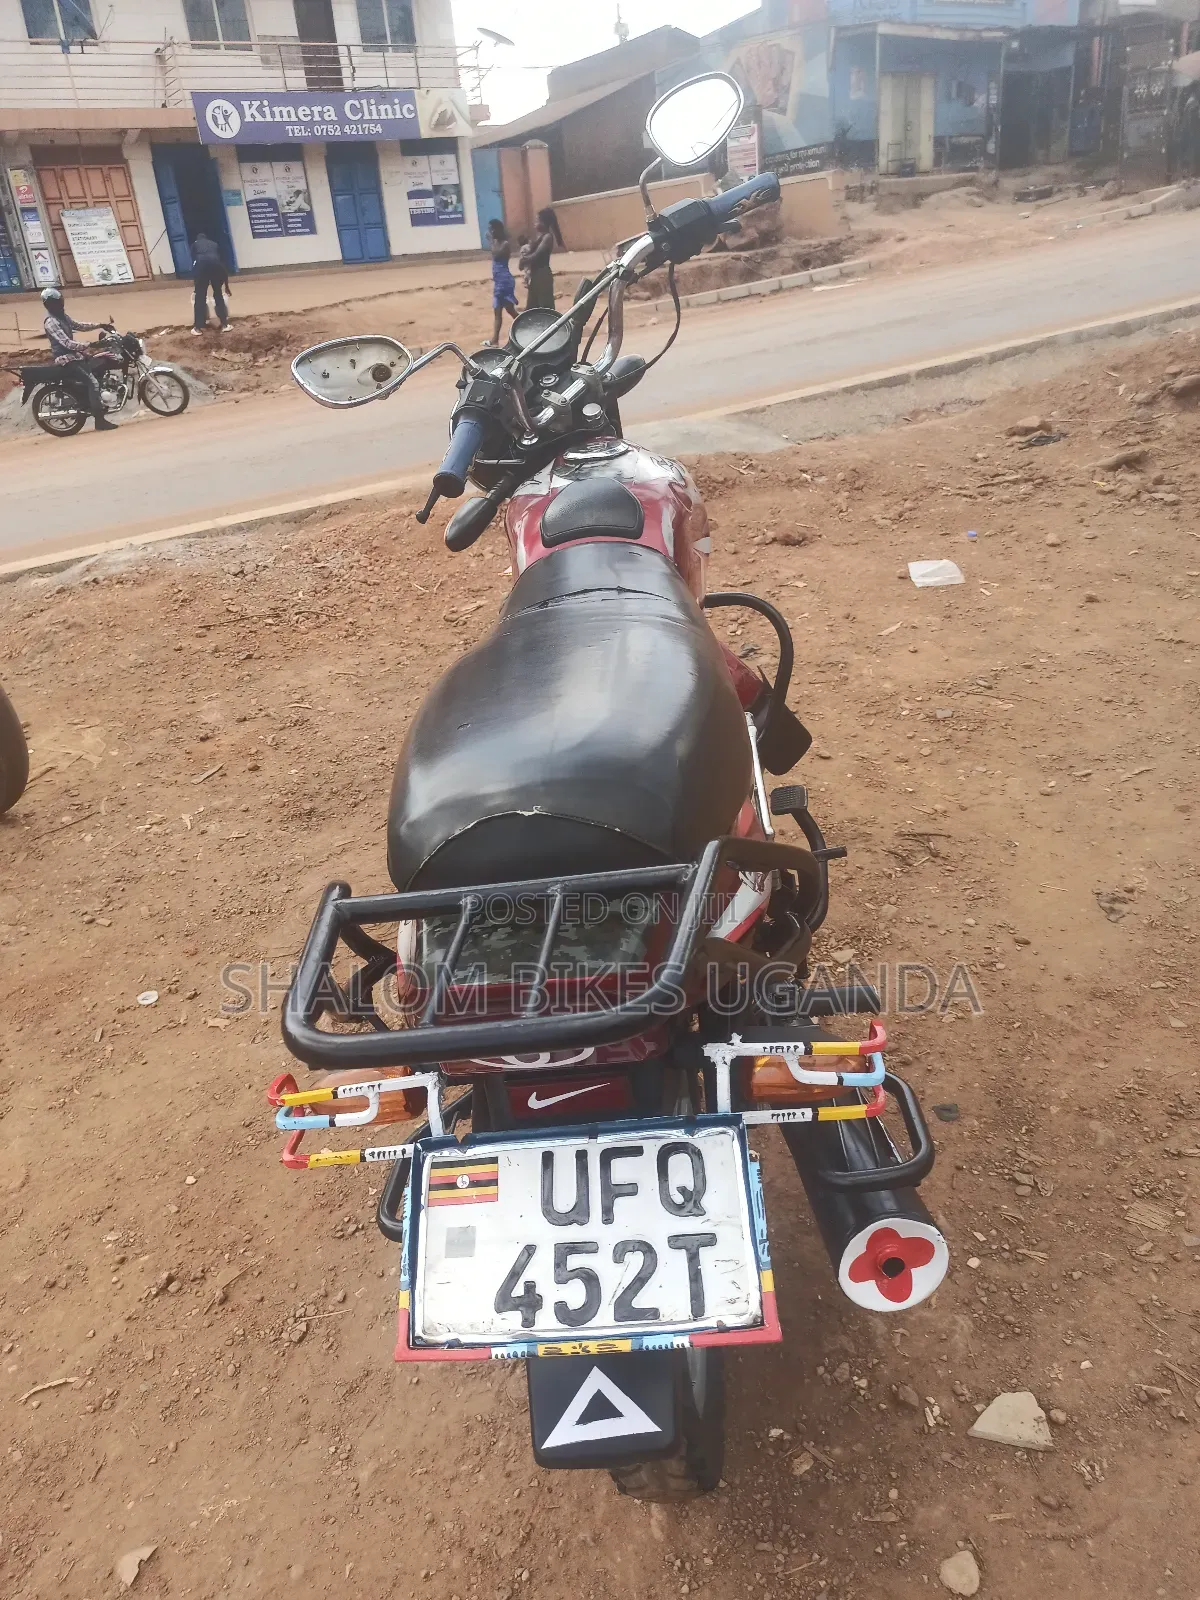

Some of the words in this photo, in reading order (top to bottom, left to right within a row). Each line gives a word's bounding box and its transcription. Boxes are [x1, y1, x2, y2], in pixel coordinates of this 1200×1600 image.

[241, 100, 338, 122] Kimera
[344, 98, 416, 120] Clinic
[286, 125, 312, 137] TEL:
[314, 124, 341, 136] 0752
[343, 123, 383, 135] 421754
[541, 1142, 706, 1226] UFQ
[494, 1232, 717, 1328] 452T
